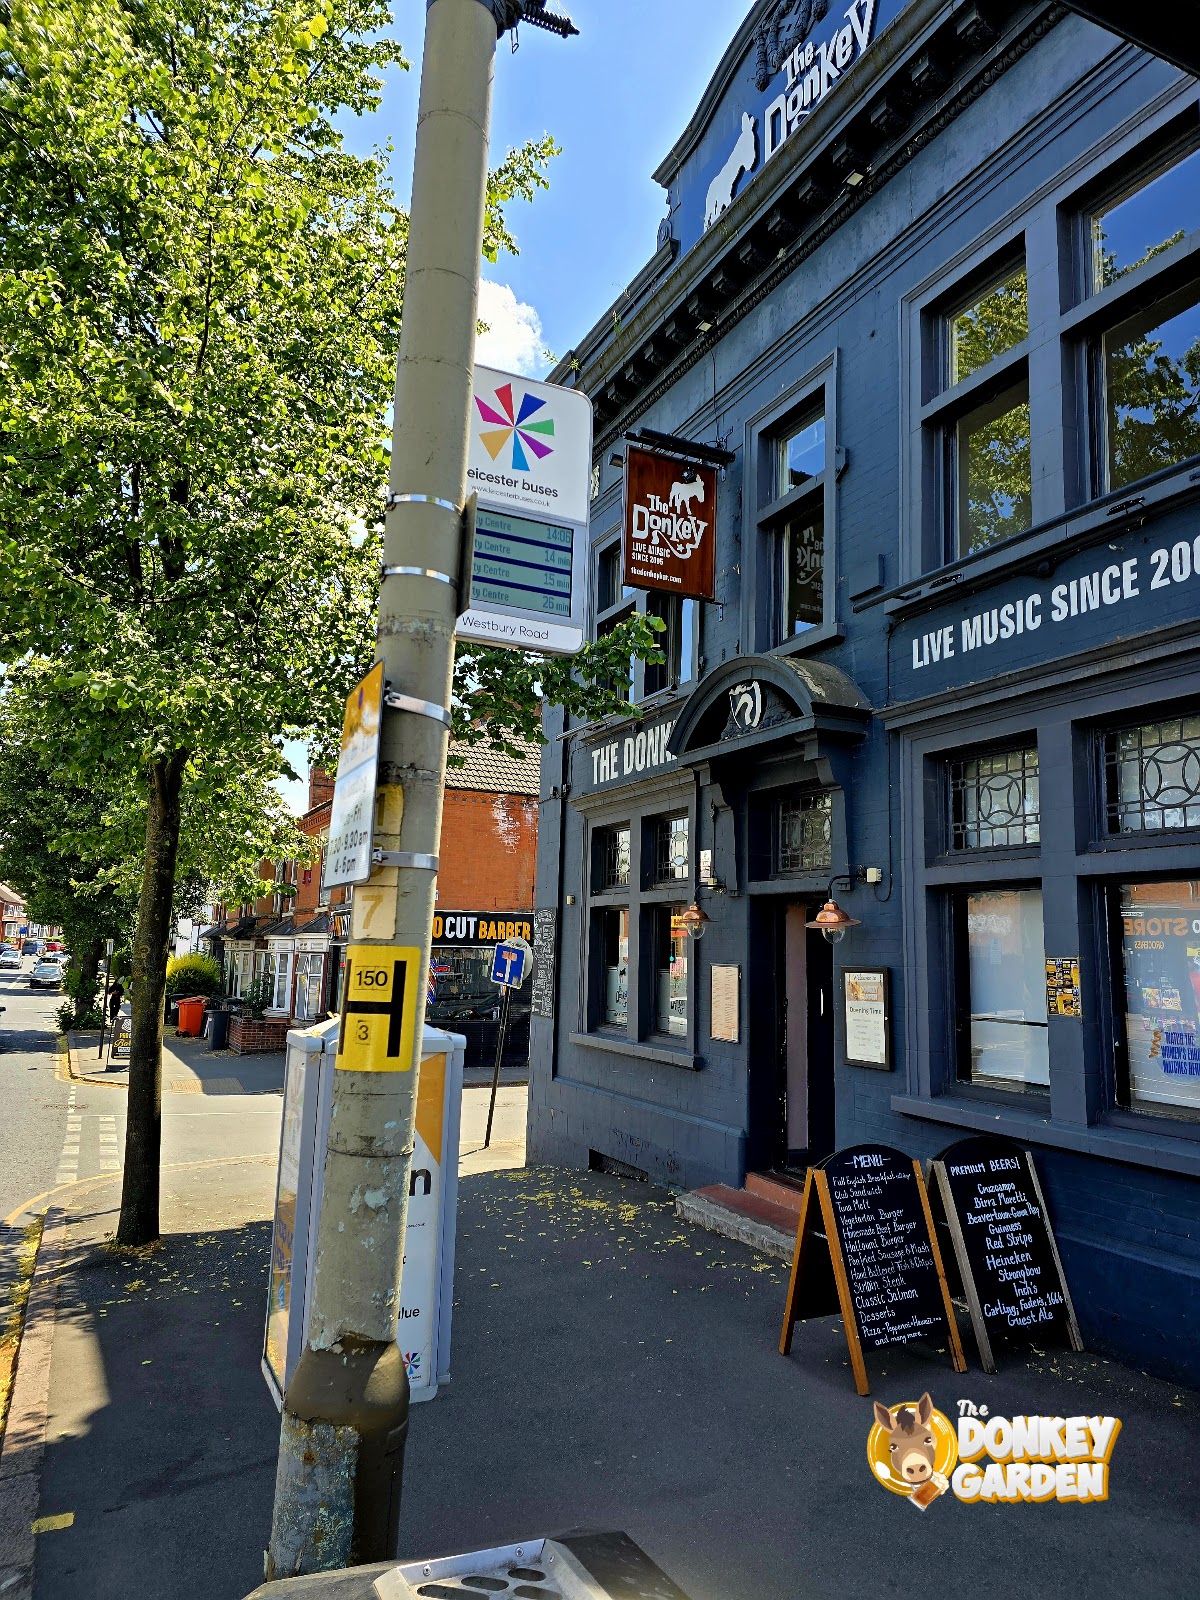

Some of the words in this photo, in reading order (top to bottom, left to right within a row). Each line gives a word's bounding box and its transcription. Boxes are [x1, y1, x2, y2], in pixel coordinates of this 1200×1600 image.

[782, 42, 815, 91] The
[764, 0, 874, 164] Donkey
[466, 468, 519, 488] eicester
[521, 478, 559, 498] buses
[646, 493, 669, 515] The
[485, 517, 512, 531] Centre
[546, 527, 572, 544] 14:06
[631, 503, 709, 548] Donkey
[484, 540, 511, 555] Centre
[544, 549, 555, 563] 14
[557, 556, 571, 567] min
[631, 551, 649, 563] SINCE
[632, 541, 647, 553] LIVE
[647, 544, 671, 558] MUSIC
[483, 563, 510, 578] Centre
[543, 573, 555, 587] 15
[556, 578, 570, 590] min
[482, 586, 509, 601] Centre
[542, 595, 555, 609] 26
[555, 602, 569, 613] min
[912, 625, 955, 669] LIVE
[961, 593, 1042, 653] MUSIC
[1051, 558, 1139, 622] SINCE
[462, 615, 517, 637] Westbury
[519, 625, 549, 640] Road
[591, 739, 619, 785] THE
[623, 718, 678, 776] DONK
[361, 894, 382, 930] 7
[445, 916, 477, 939] CUT
[479, 920, 531, 941] BARBER
[356, 970, 388, 987] 150
[358, 1025, 369, 1041] 3
[950, 1163, 986, 1177] PREMIUM
[989, 1156, 1020, 1171] BEERS!
[832, 1176, 846, 1187] Full
[846, 1175, 867, 1187] English
[977, 1182, 1016, 1195] Cruzcampo
[835, 1189, 849, 1200] Club
[849, 1184, 883, 1198] Sandwich
[974, 1196, 998, 1209] Birra
[998, 1190, 1028, 1206] Moretti
[835, 1201, 852, 1213] Tuna
[852, 1198, 871, 1211] Melt
[840, 1213, 876, 1230] Vegetarian
[878, 1208, 904, 1222] Burger
[988, 1221, 1022, 1235] Guinness
[843, 1225, 876, 1240] Homemade
[892, 1221, 917, 1234] Burger
[845, 1239, 879, 1253] Halloumi
[880, 1234, 905, 1249] Burger
[877, 1249, 905, 1262] Sausage
[910, 1240, 930, 1254] Mash
[985, 1235, 1005, 1250] Red
[1006, 1232, 1033, 1248] Stripe
[914, 1256, 934, 1270] Chips
[985, 1250, 1033, 1271] Heineken
[881, 1274, 907, 1288] Steak
[998, 1264, 1041, 1284] Strongbow
[855, 1293, 886, 1309] Classic
[886, 1288, 919, 1303] Salmon
[1012, 1281, 1038, 1298] Inch's
[1046, 1291, 1064, 1306] 1664
[858, 1306, 896, 1324] Desserts
[1007, 1310, 1038, 1327] Guest
[1038, 1307, 1054, 1321] Ale
[874, 1334, 890, 1346] and
[890, 1334, 908, 1344] many
